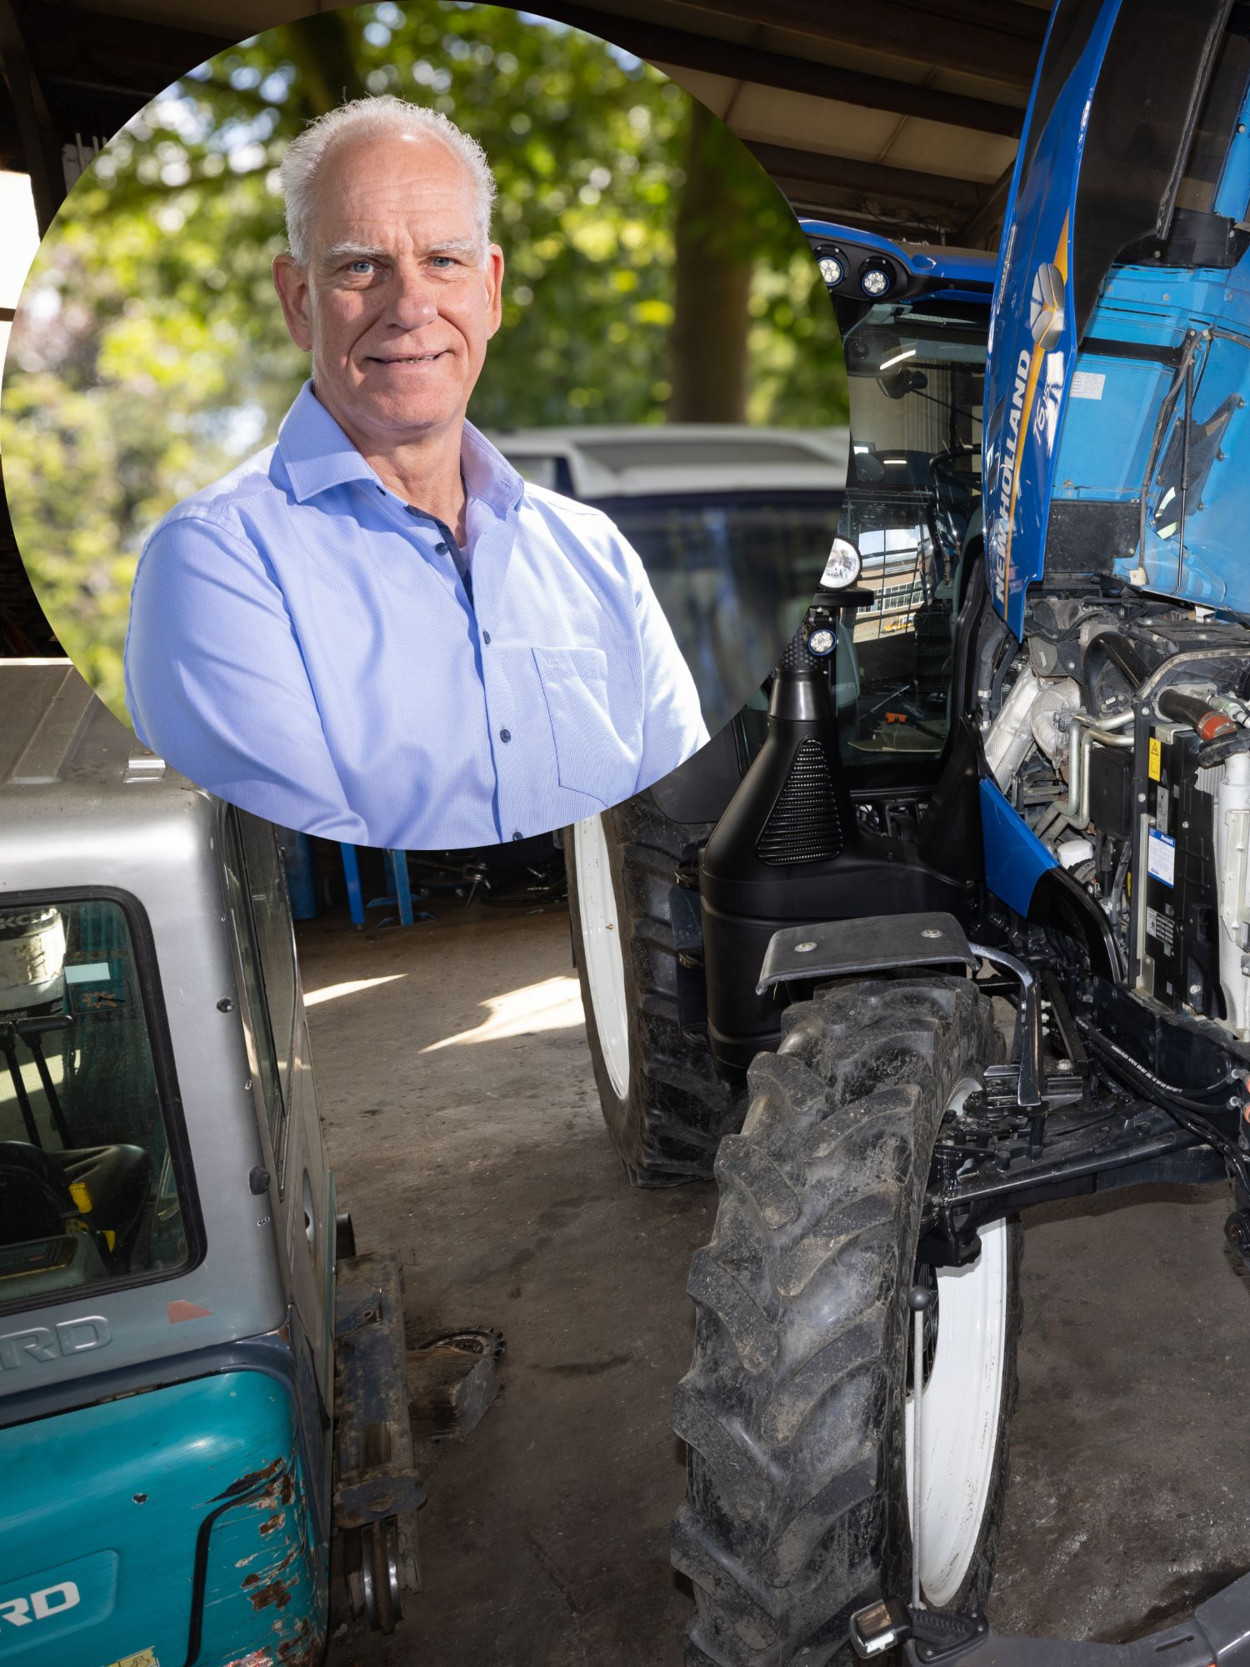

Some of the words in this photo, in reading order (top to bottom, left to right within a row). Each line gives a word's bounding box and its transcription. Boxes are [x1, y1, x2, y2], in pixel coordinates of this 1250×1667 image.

[999, 349, 1031, 521] HOLLAND
[995, 520, 1008, 604] NEW
[0, 1315, 112, 1372] RD
[0, 1581, 80, 1628] RD
